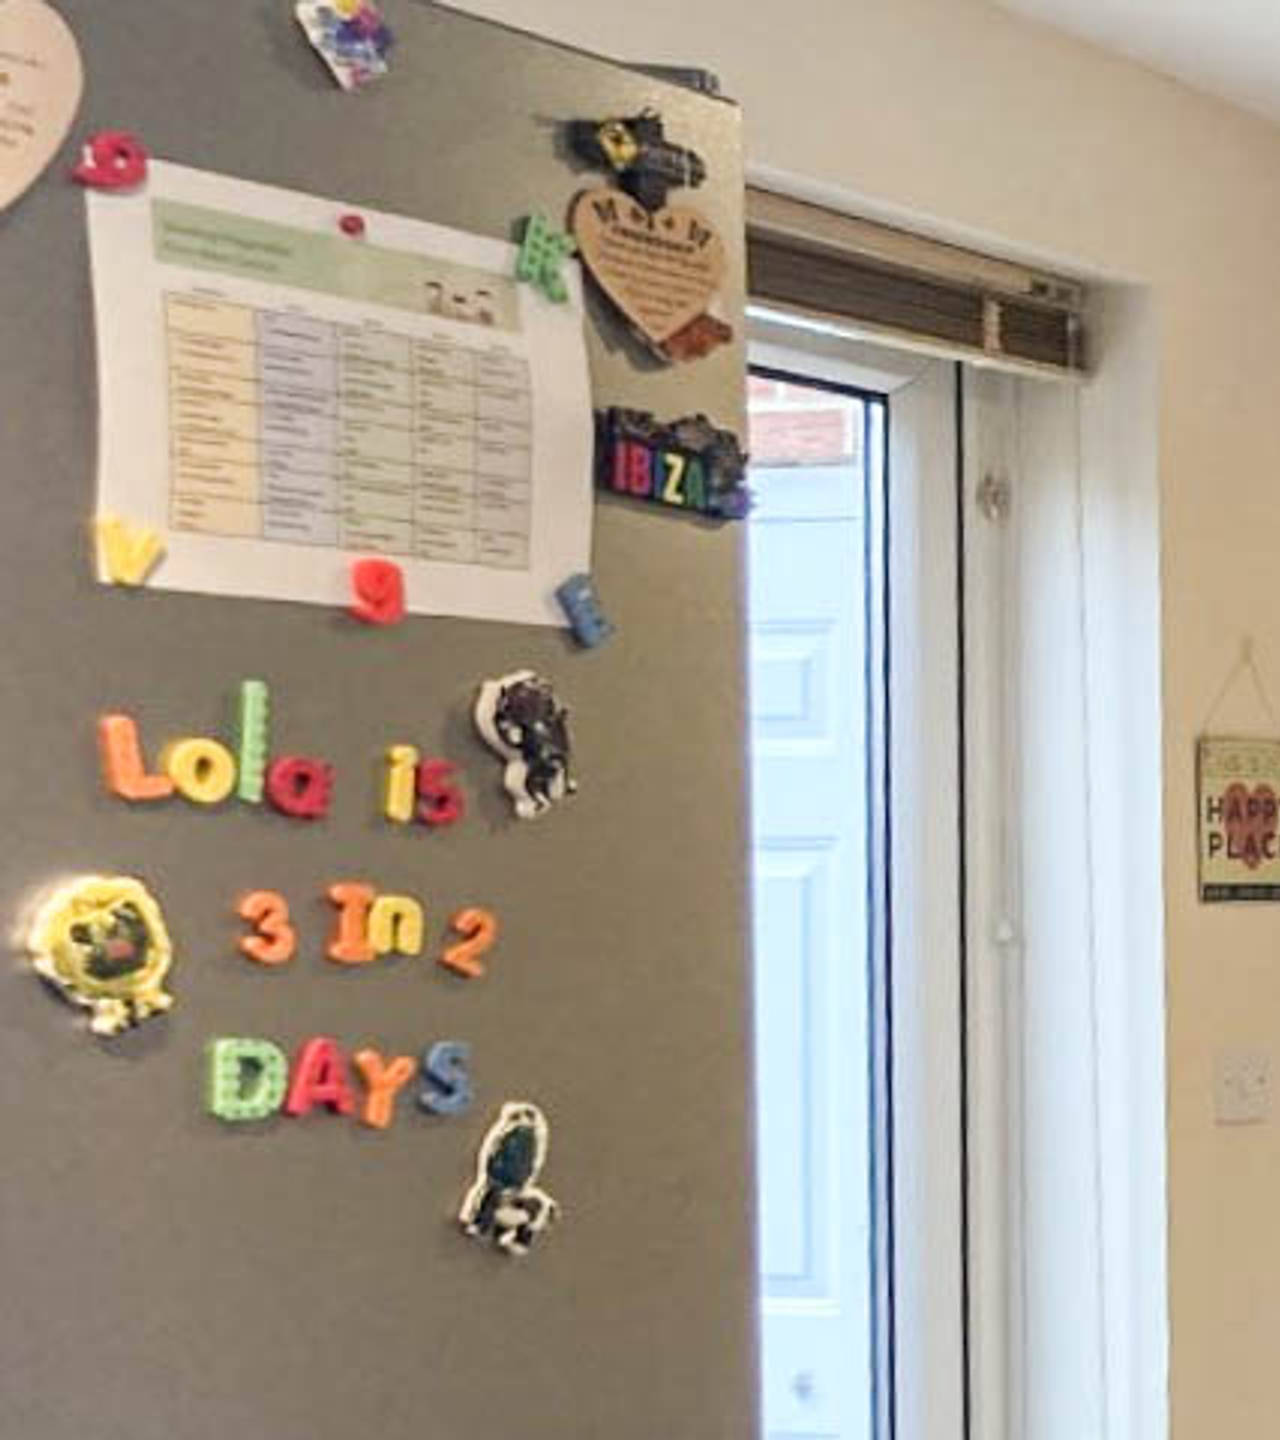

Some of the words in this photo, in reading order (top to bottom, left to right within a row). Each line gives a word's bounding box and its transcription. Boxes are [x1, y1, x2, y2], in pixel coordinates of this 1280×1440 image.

[100, 680, 335, 820] Lola
[237, 890, 295, 964] 3
[328, 881, 425, 964] In
[437, 907, 498, 978] 2
[209, 1036, 473, 1128] DAYS
